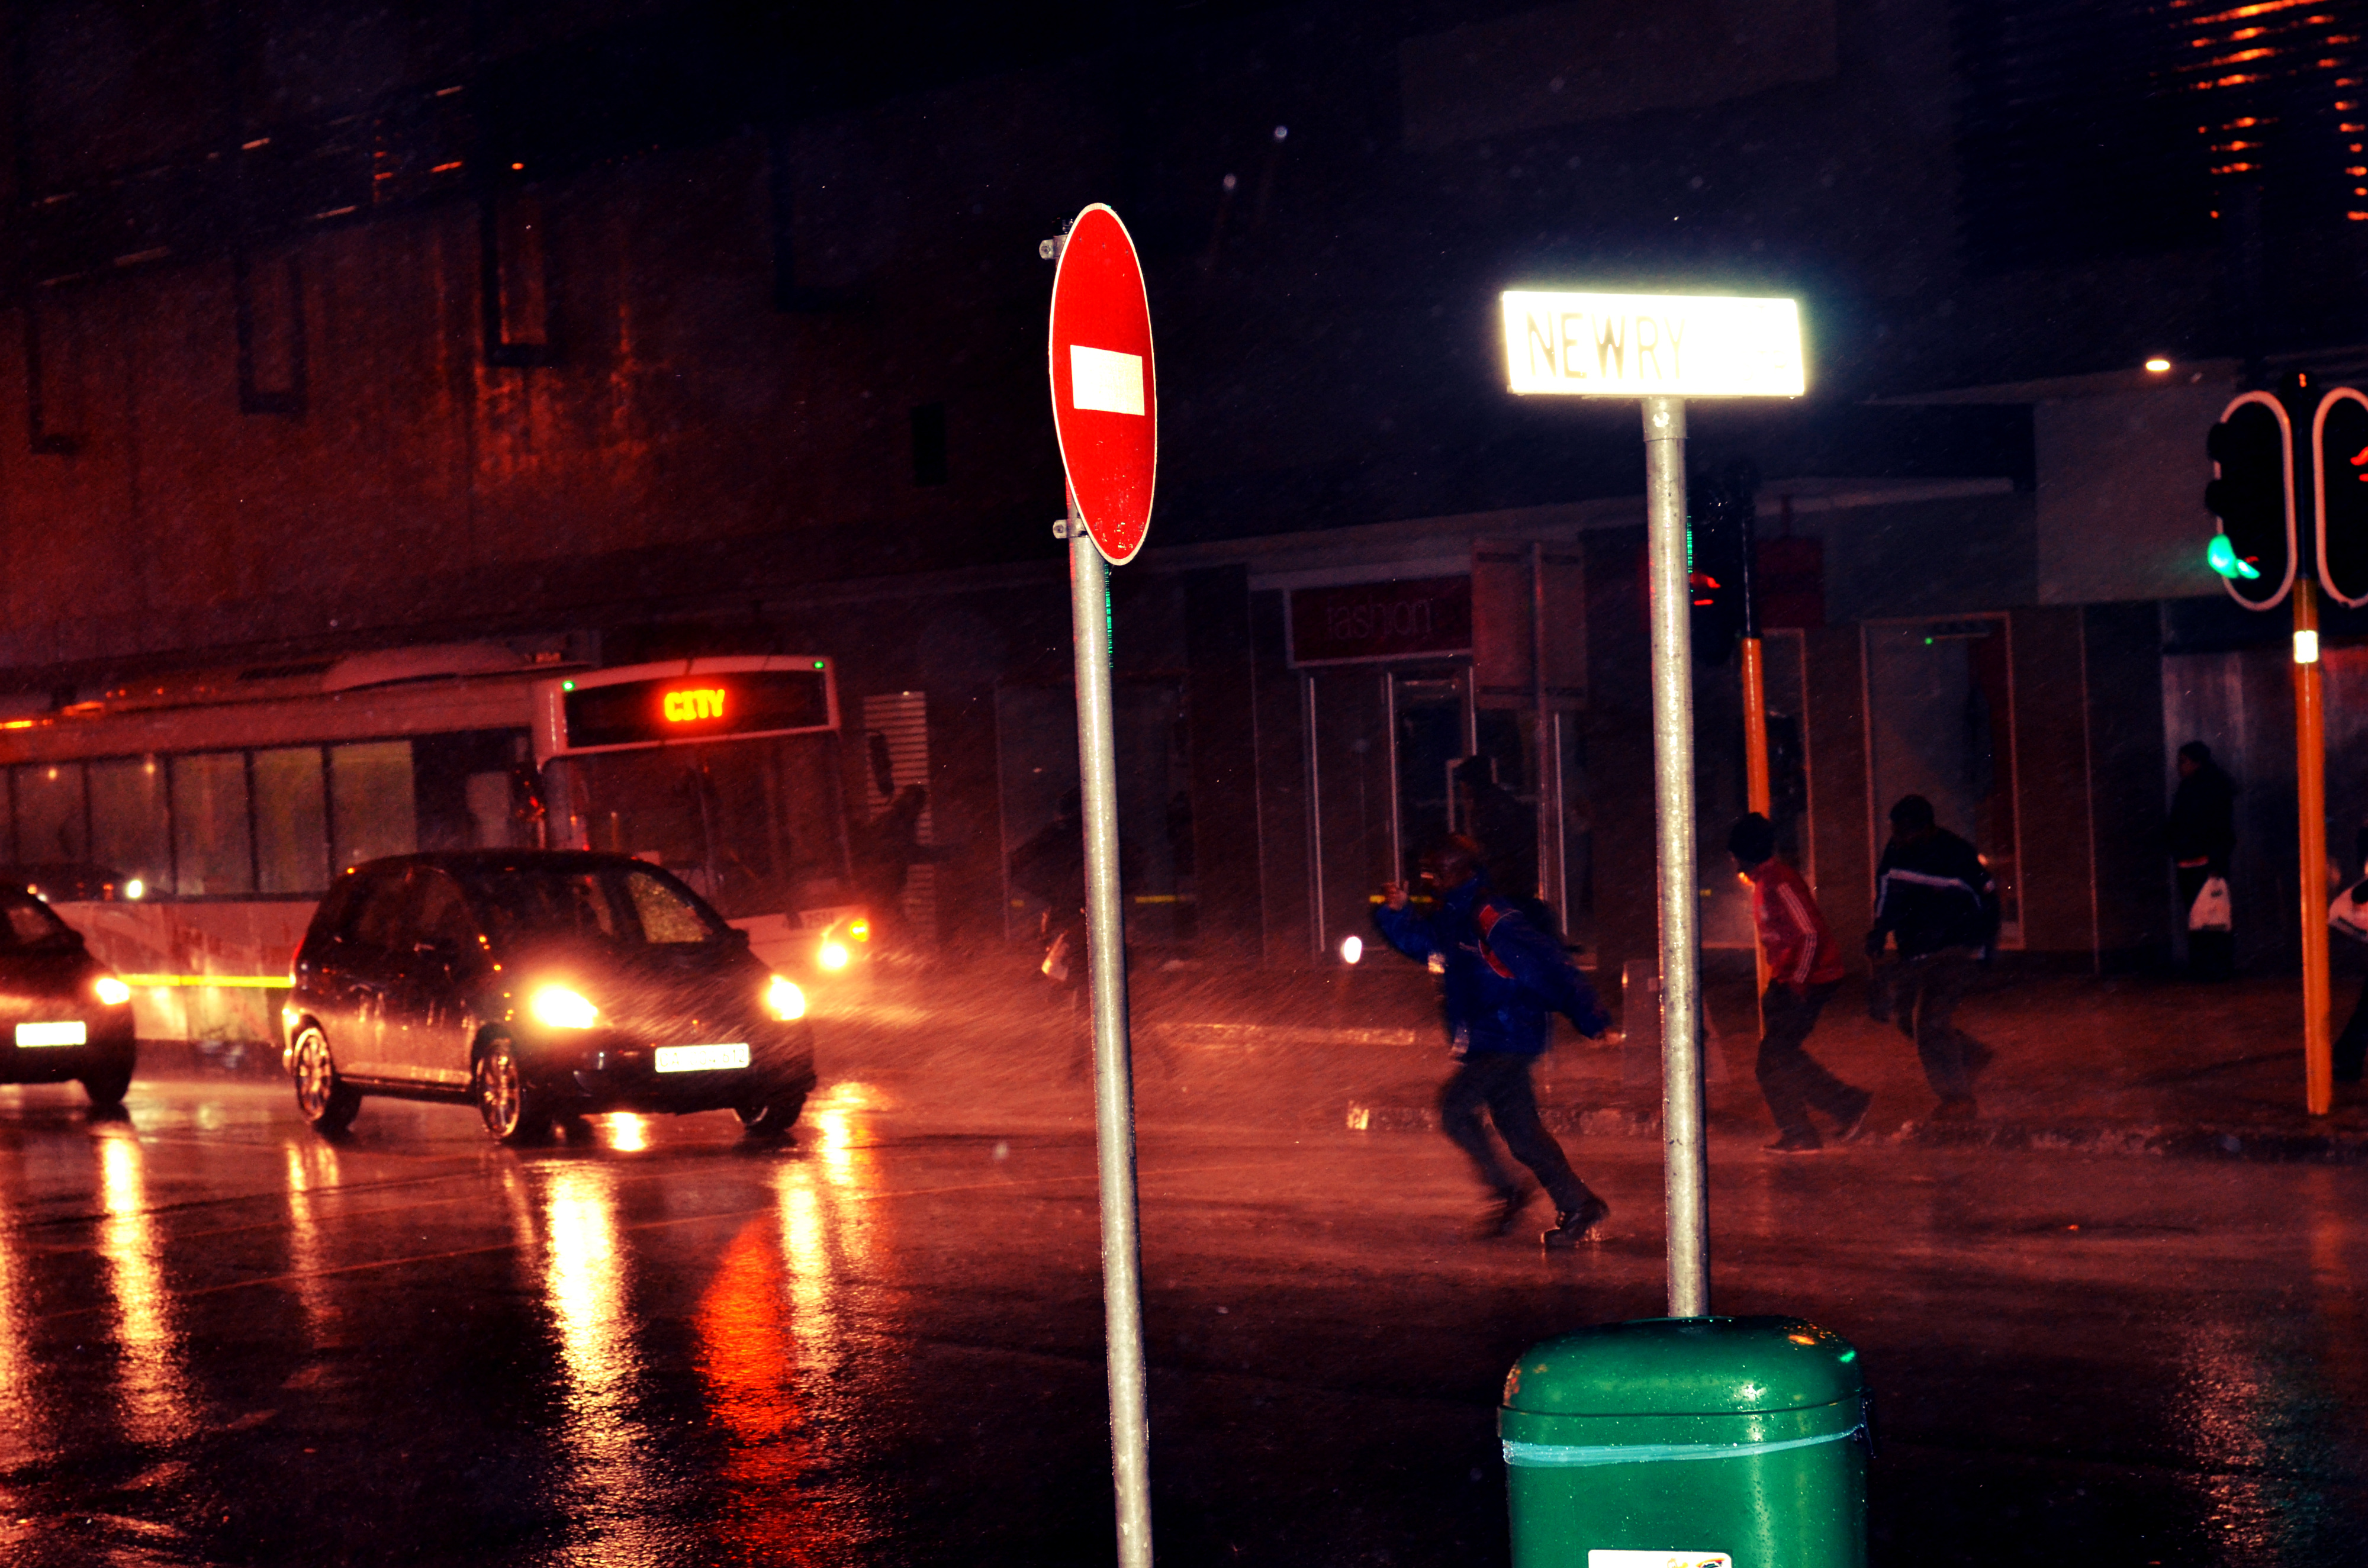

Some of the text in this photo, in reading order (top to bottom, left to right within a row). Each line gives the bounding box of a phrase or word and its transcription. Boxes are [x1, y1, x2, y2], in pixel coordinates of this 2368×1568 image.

[1526, 310, 1685, 380] NEWRY
[1326, 593, 1431, 640] fashion
[664, 688, 726, 722] CITY
